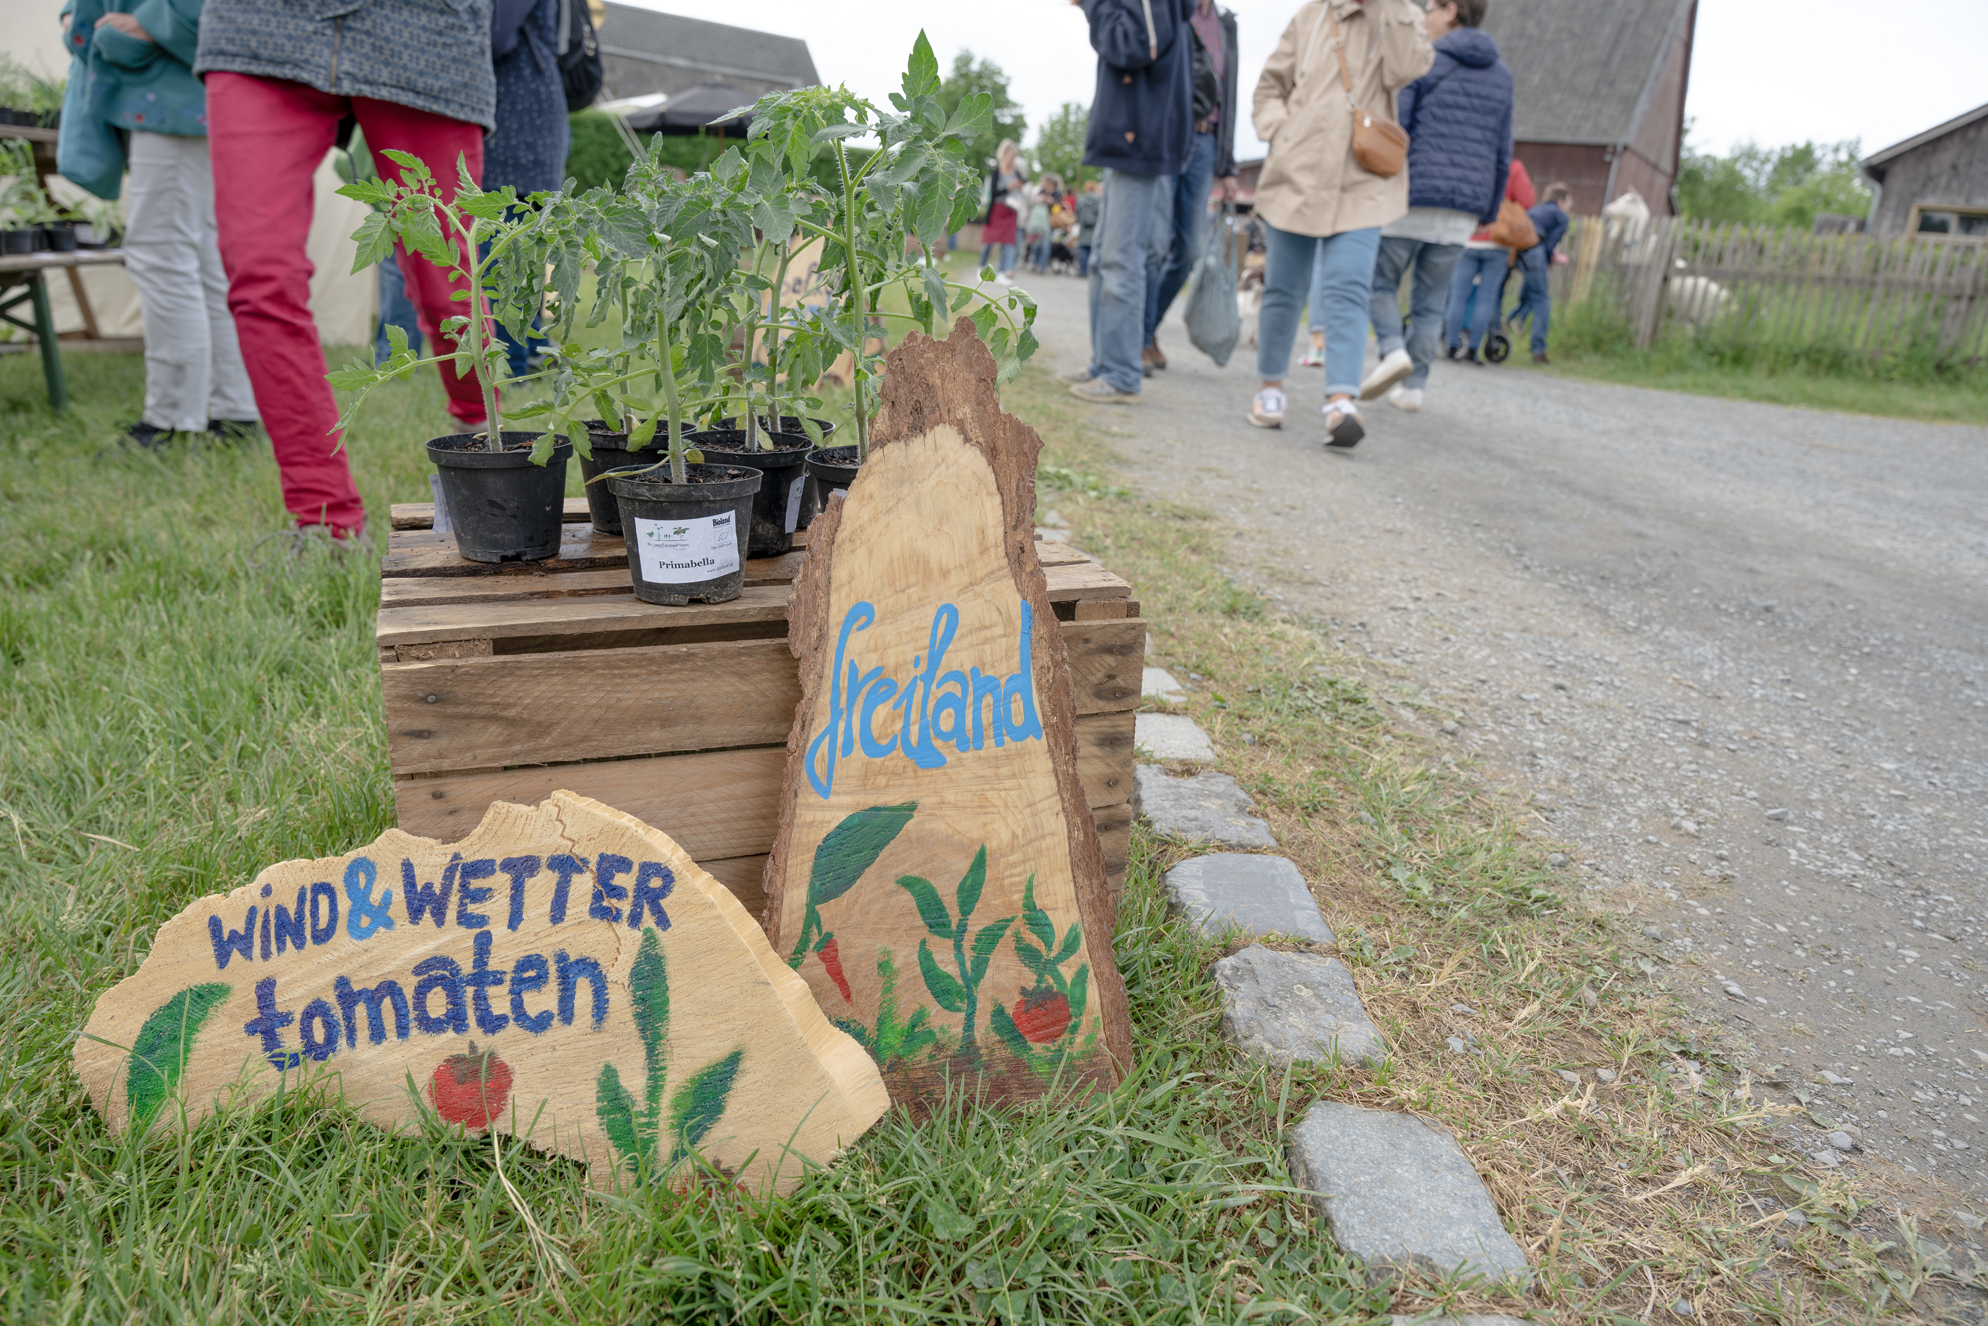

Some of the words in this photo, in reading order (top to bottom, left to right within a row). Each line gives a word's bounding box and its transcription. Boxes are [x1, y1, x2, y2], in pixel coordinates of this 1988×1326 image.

[712, 515, 731, 526] Bioland
[659, 557, 715, 569] Primabella
[344, 856, 395, 942] &
[401, 852, 675, 932] WETTER
[244, 930, 610, 1072] tomaten
